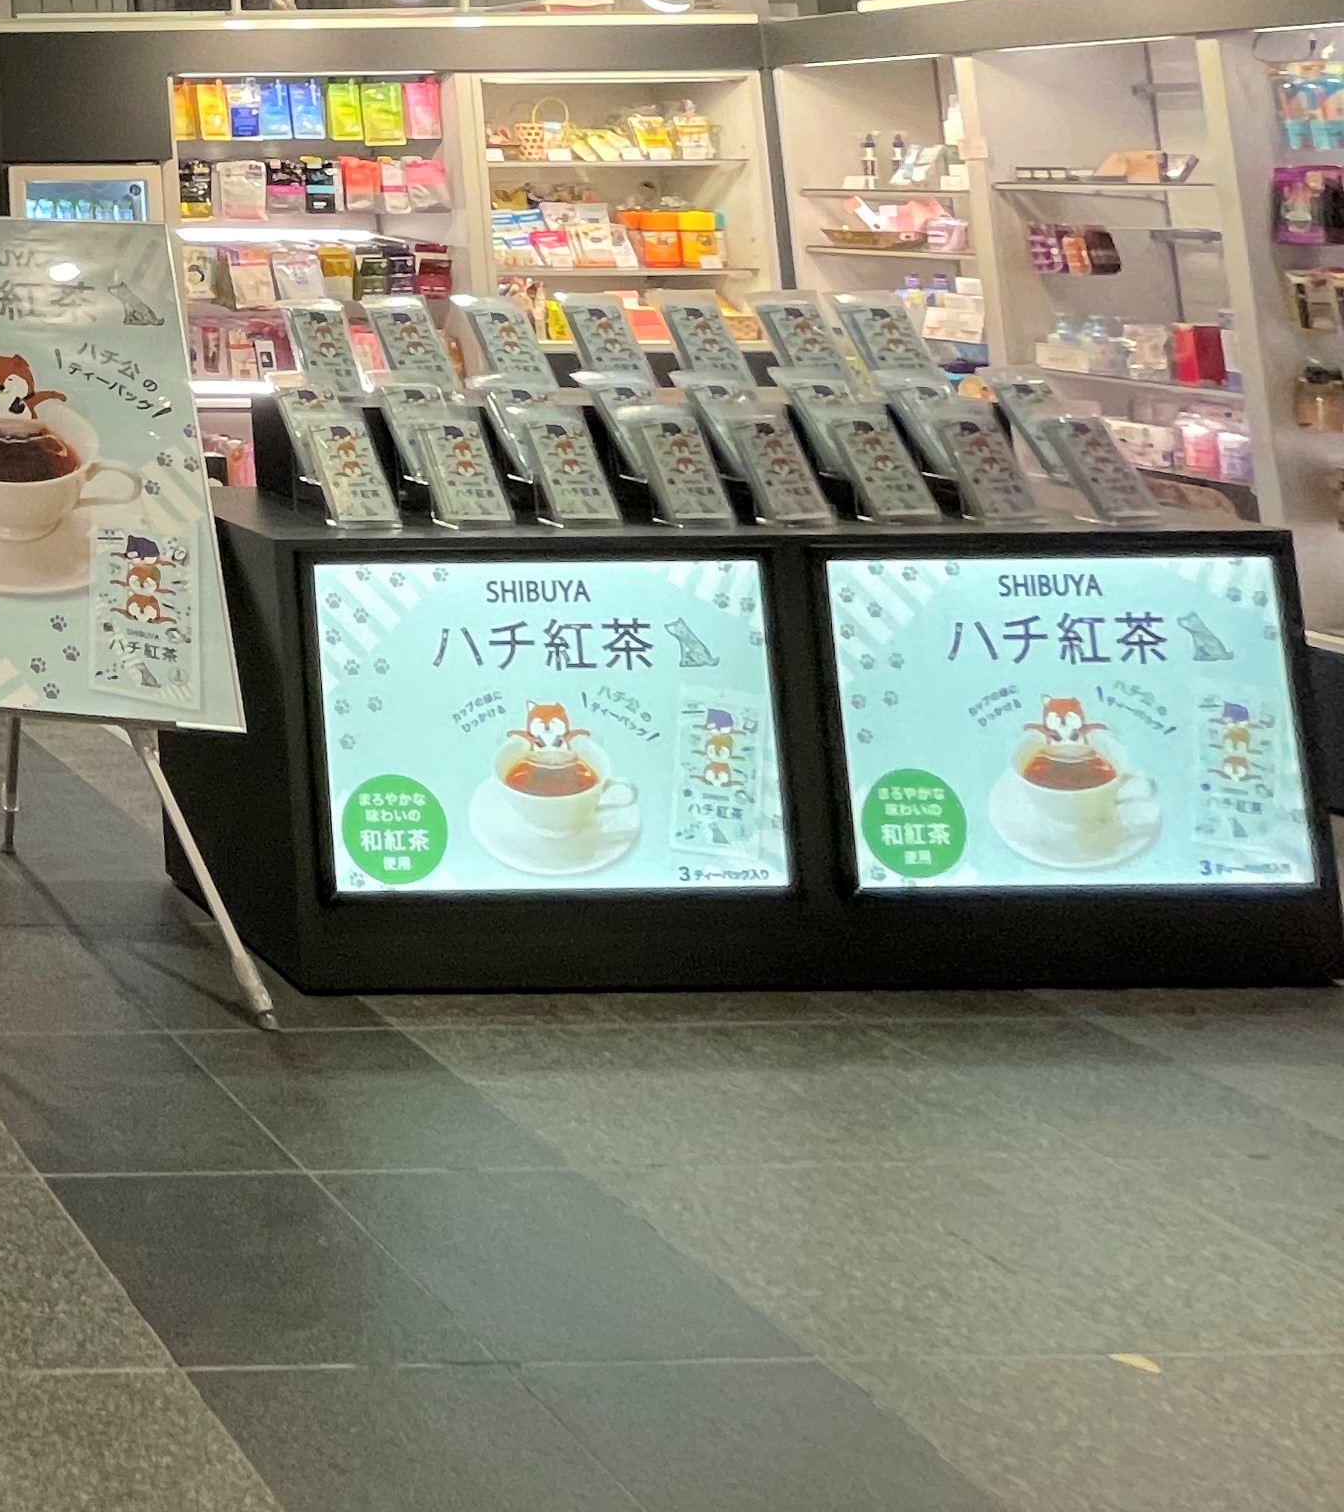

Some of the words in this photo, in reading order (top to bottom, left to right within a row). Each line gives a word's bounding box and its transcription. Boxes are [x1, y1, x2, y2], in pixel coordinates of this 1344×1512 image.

[486, 580, 591, 603] SHIBUYA
[998, 573, 1104, 597] SHIBUYA
[433, 617, 654, 671] ハチ紅茶
[947, 612, 1168, 665] ハチ紅茶
[359, 828, 430, 852] 和紅茶
[880, 822, 951, 846] 和紅茶
